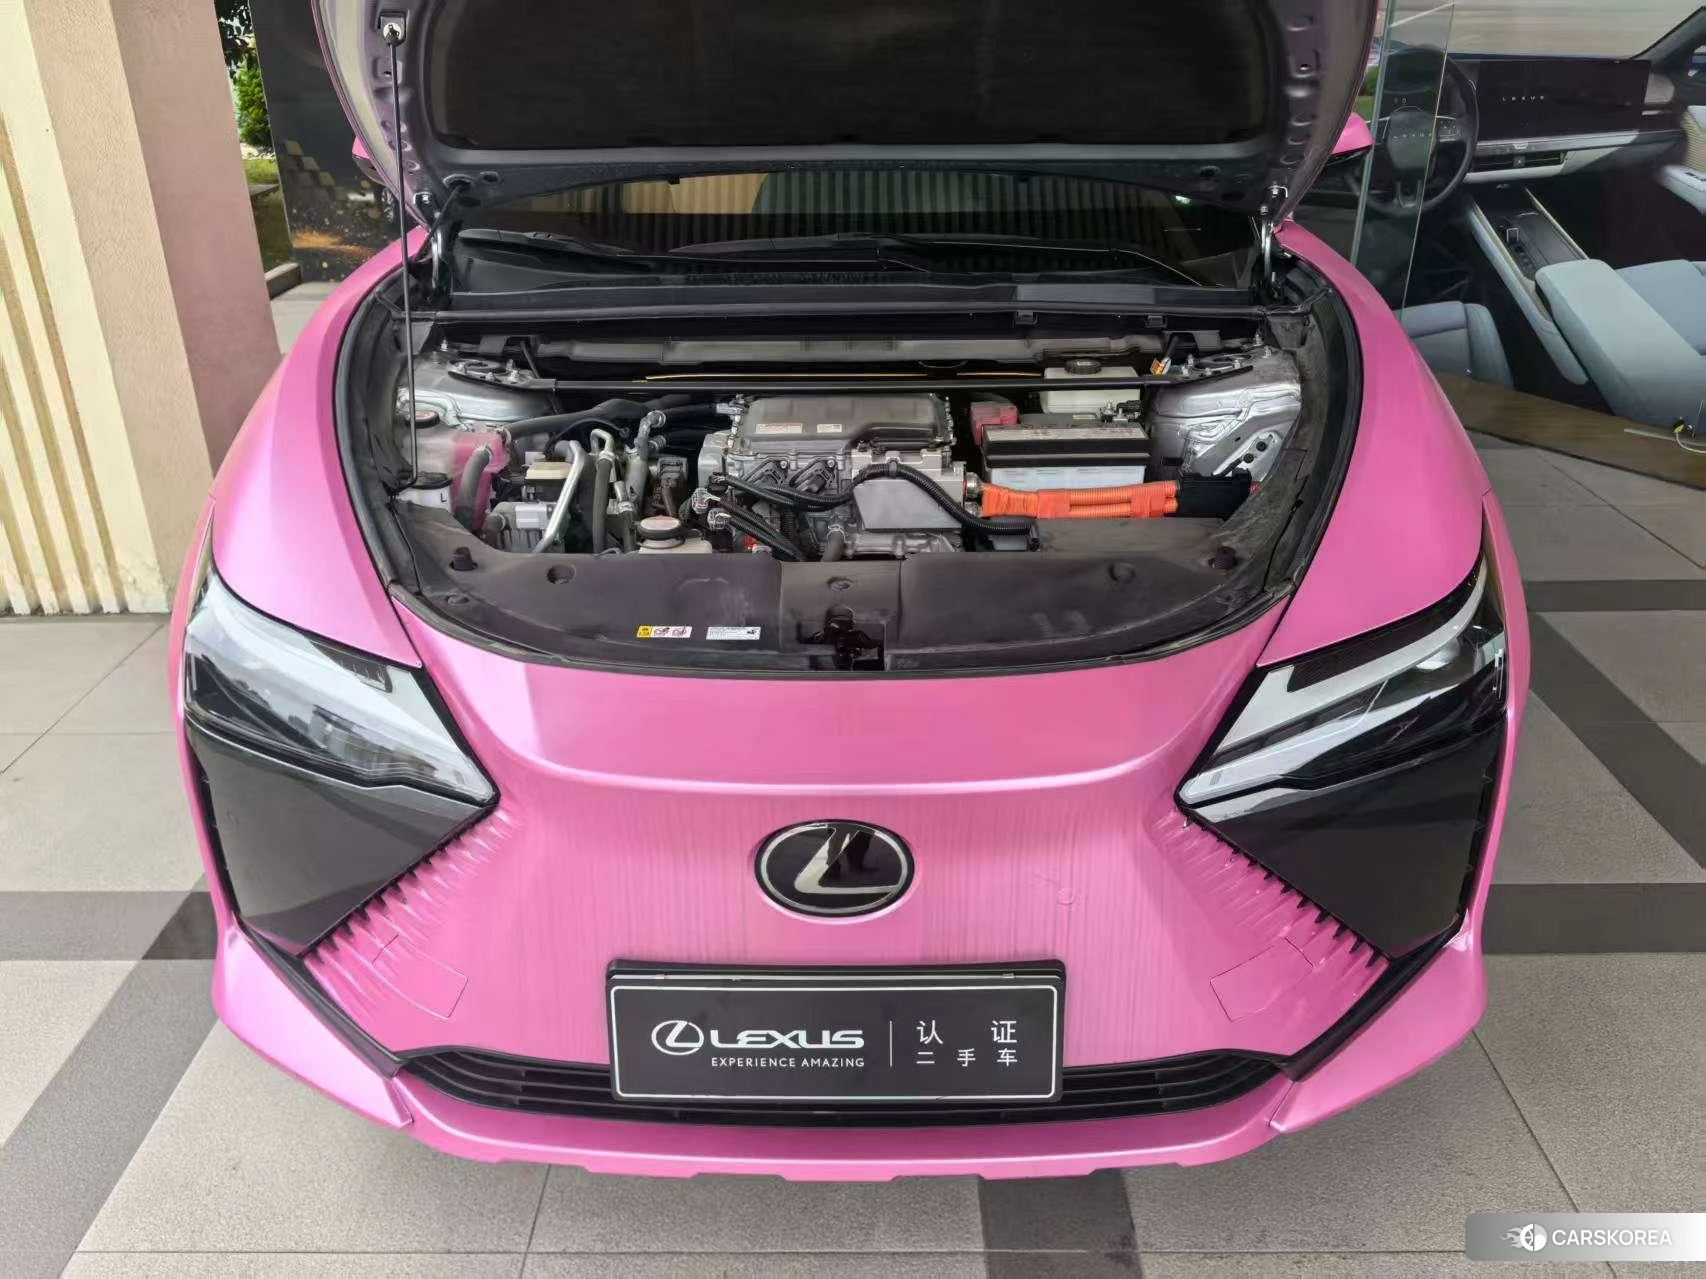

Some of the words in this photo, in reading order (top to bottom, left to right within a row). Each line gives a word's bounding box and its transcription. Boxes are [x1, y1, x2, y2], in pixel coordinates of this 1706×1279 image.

[710, 1030, 865, 1049] LEXUS
[711, 1057, 796, 1068] EXPERIENCE
[801, 1057, 865, 1068] AMAZING
